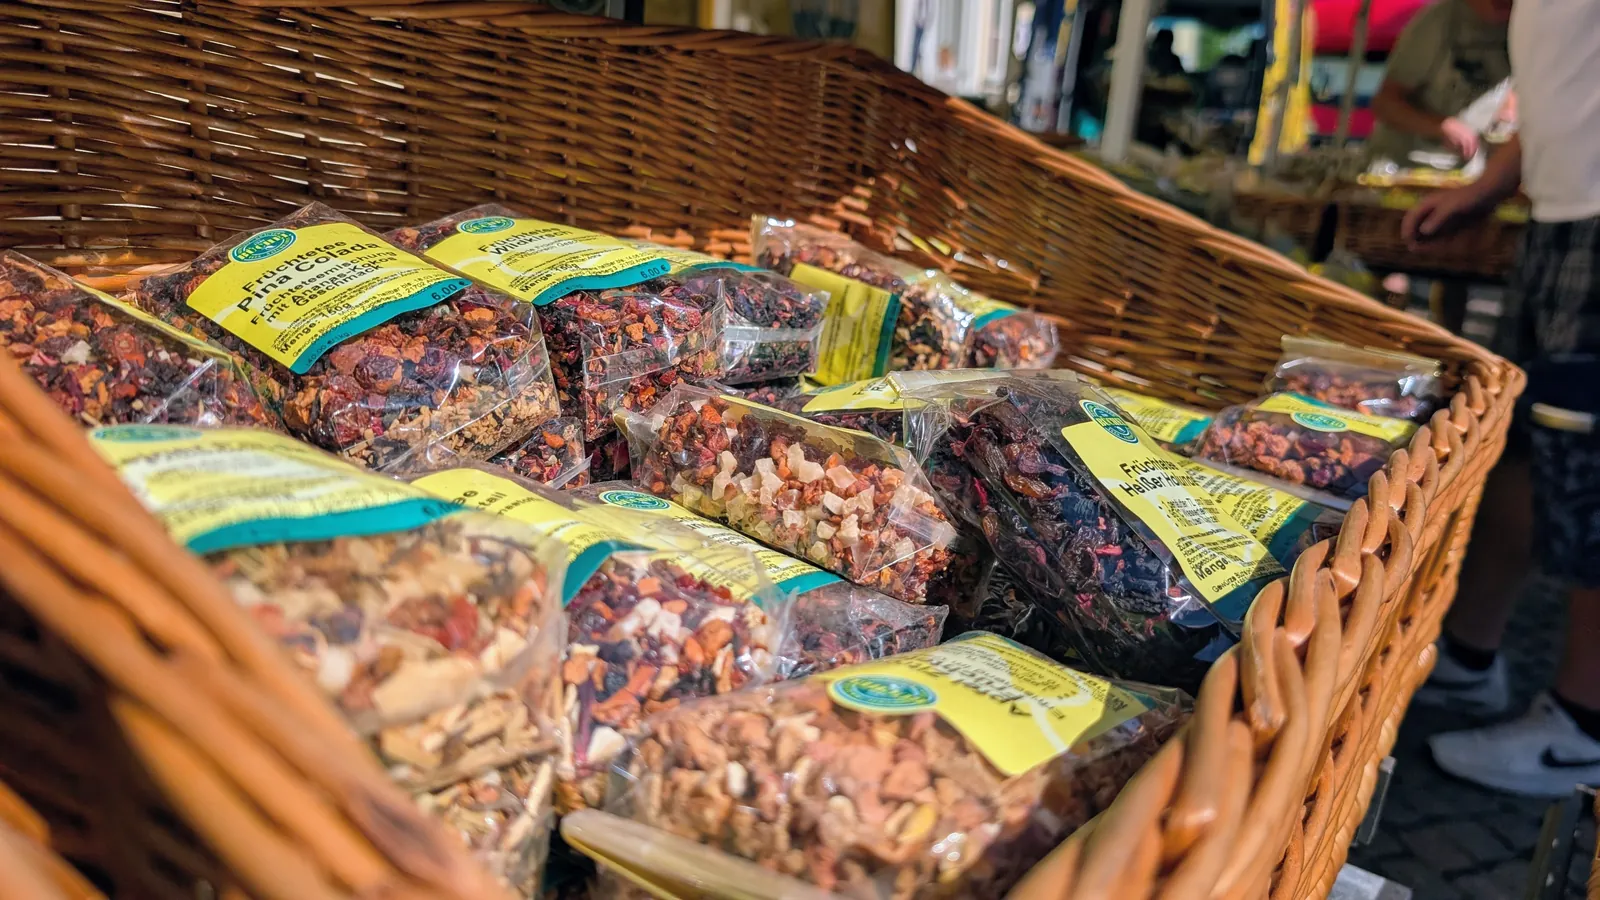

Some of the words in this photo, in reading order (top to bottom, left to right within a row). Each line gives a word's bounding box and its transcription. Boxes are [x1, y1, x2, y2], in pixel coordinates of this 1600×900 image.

[478, 227, 561, 253] Früchtetee
[490, 230, 573, 255] Wildkirsch
[236, 274, 293, 312] Pina
[294, 242, 381, 272] Colada
[241, 240, 347, 293] Früchtetee
[458, 279, 467, 287] €
[660, 264, 669, 272] €
[250, 250, 398, 326] Früchteteemischung
[265, 302, 290, 324] mit
[290, 256, 398, 304] Ananas-Kokos
[294, 264, 384, 307] Geschmack
[279, 319, 321, 354] Menge:
[318, 302, 352, 318] 150g
[1119, 456, 1179, 478] Früchtetee
[1118, 475, 1166, 497] Heißer
